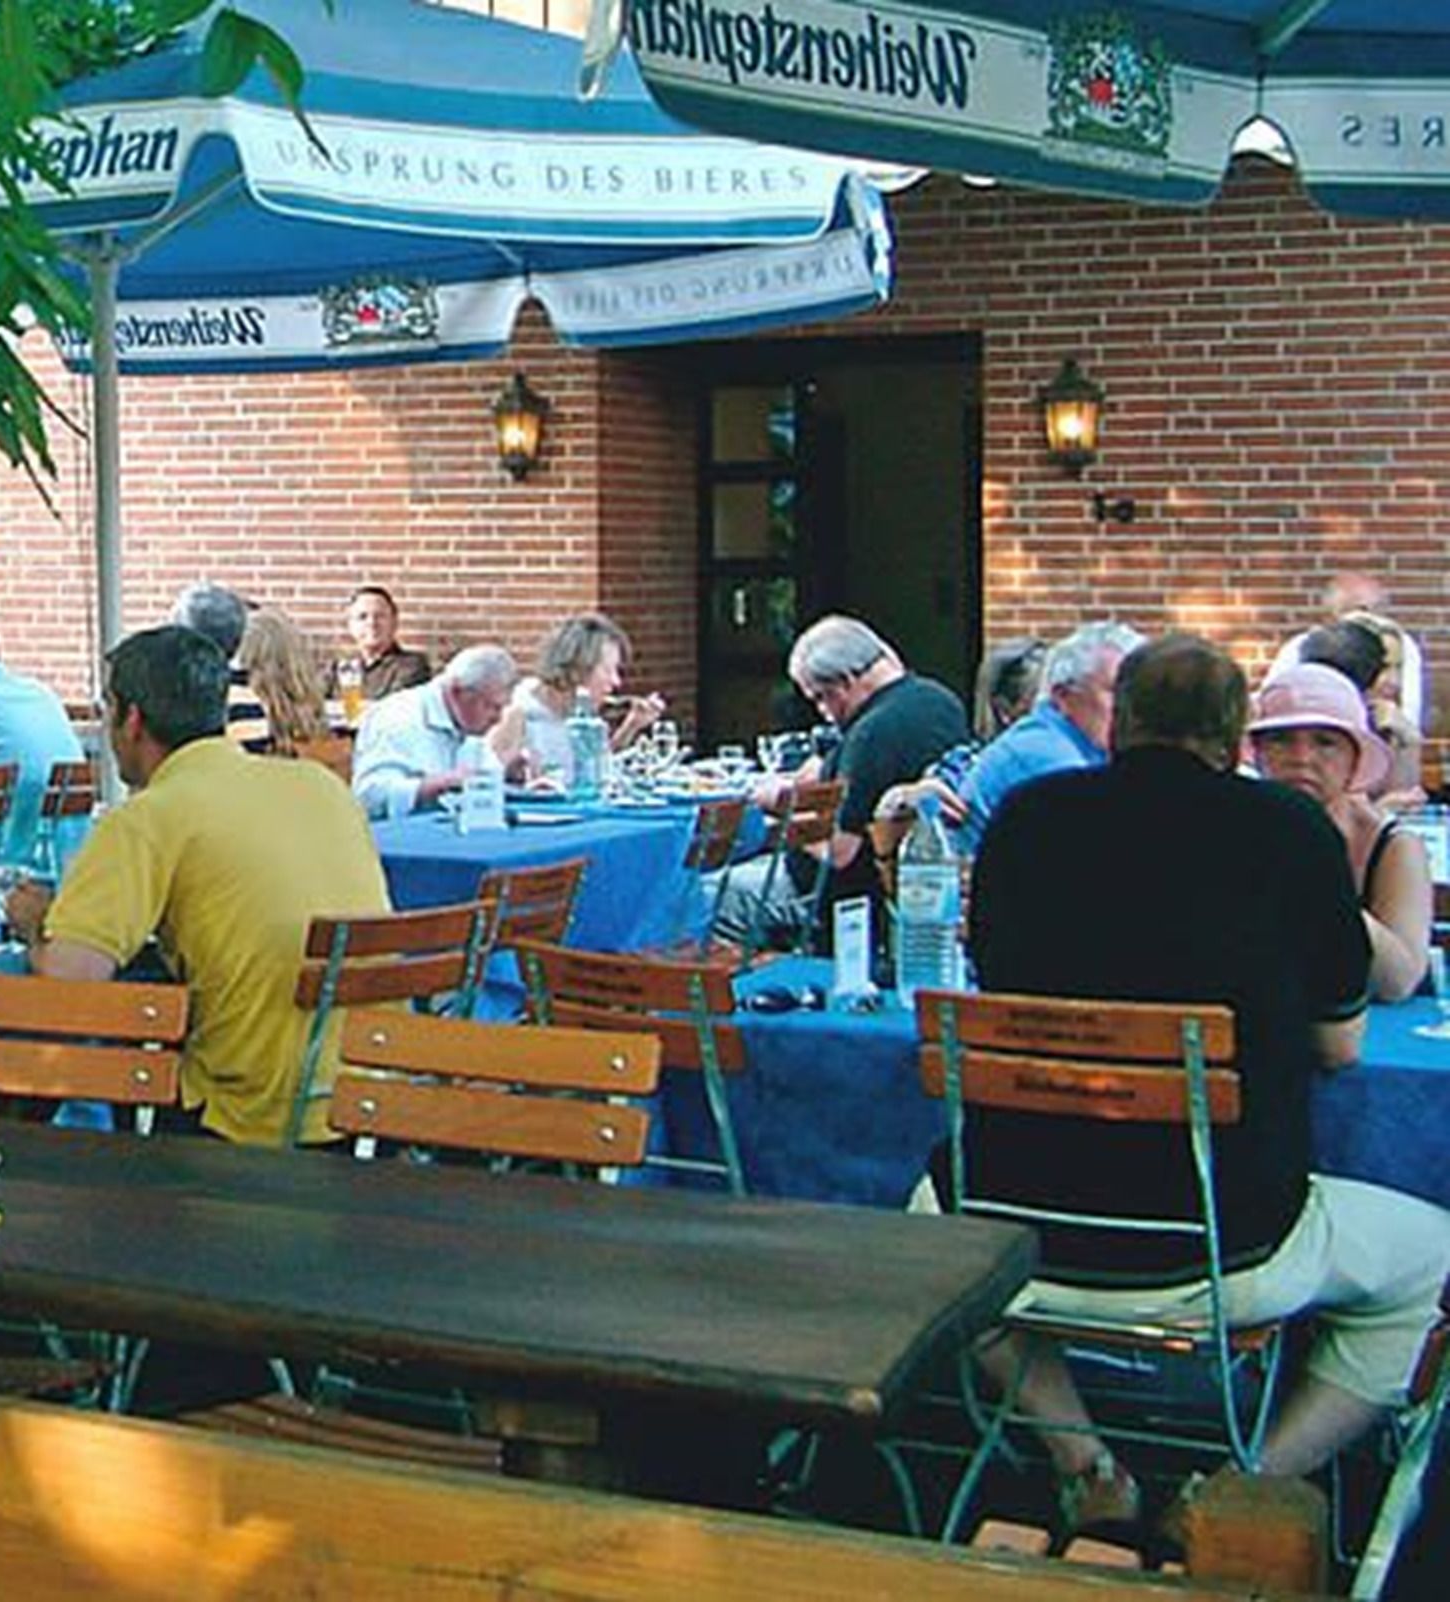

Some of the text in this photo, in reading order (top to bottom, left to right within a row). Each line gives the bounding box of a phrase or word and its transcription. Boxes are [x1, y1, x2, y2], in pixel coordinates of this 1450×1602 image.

[276, 140, 808, 193] URSPRUNG DES BIERES
